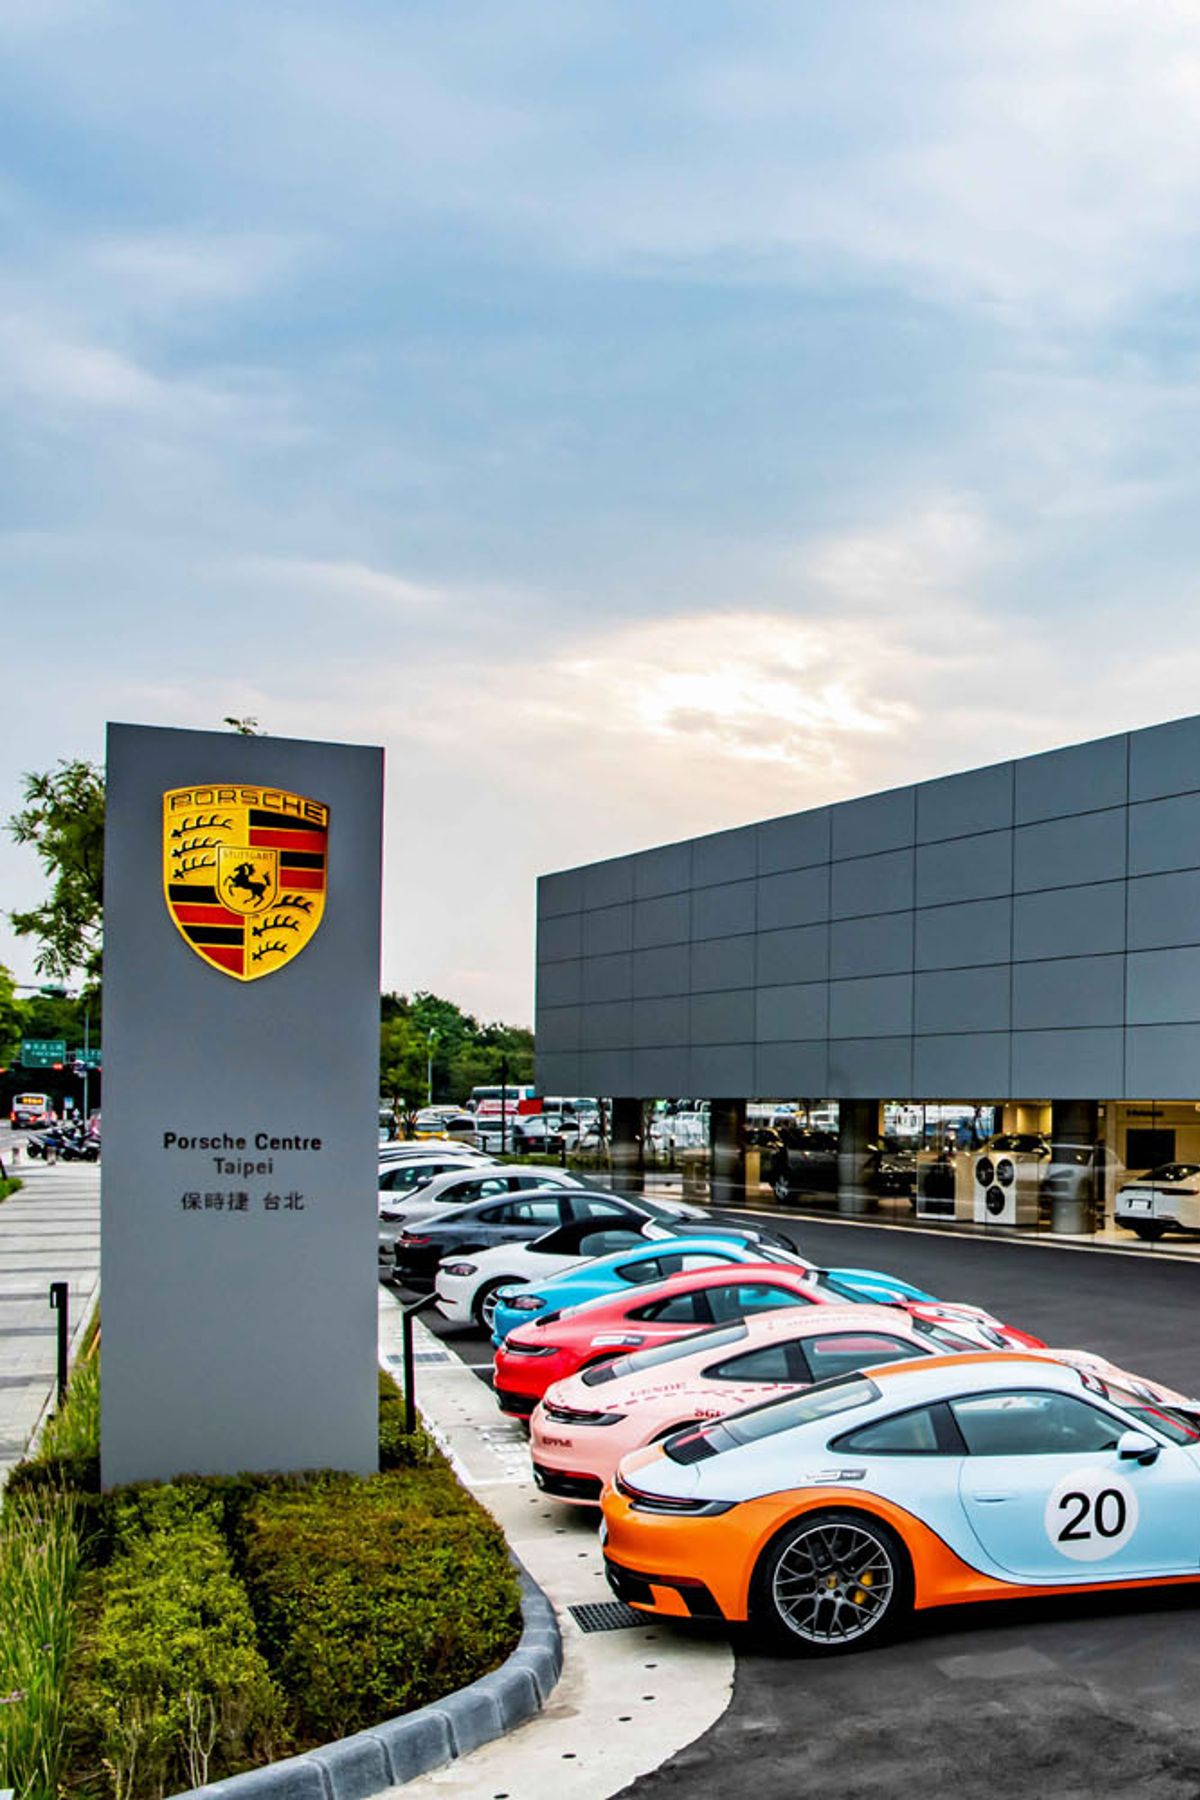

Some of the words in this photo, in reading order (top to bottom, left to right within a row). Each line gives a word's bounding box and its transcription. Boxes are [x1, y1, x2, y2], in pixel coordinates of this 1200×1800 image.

[169, 788, 324, 825] PORSCHE
[163, 1131, 247, 1150] Porsche
[255, 1132, 322, 1150] Centre
[213, 1157, 274, 1178] Taipei
[181, 1191, 250, 1212] 保時捷
[263, 1191, 306, 1211] 台北
[1058, 1488, 1127, 1542] 20
